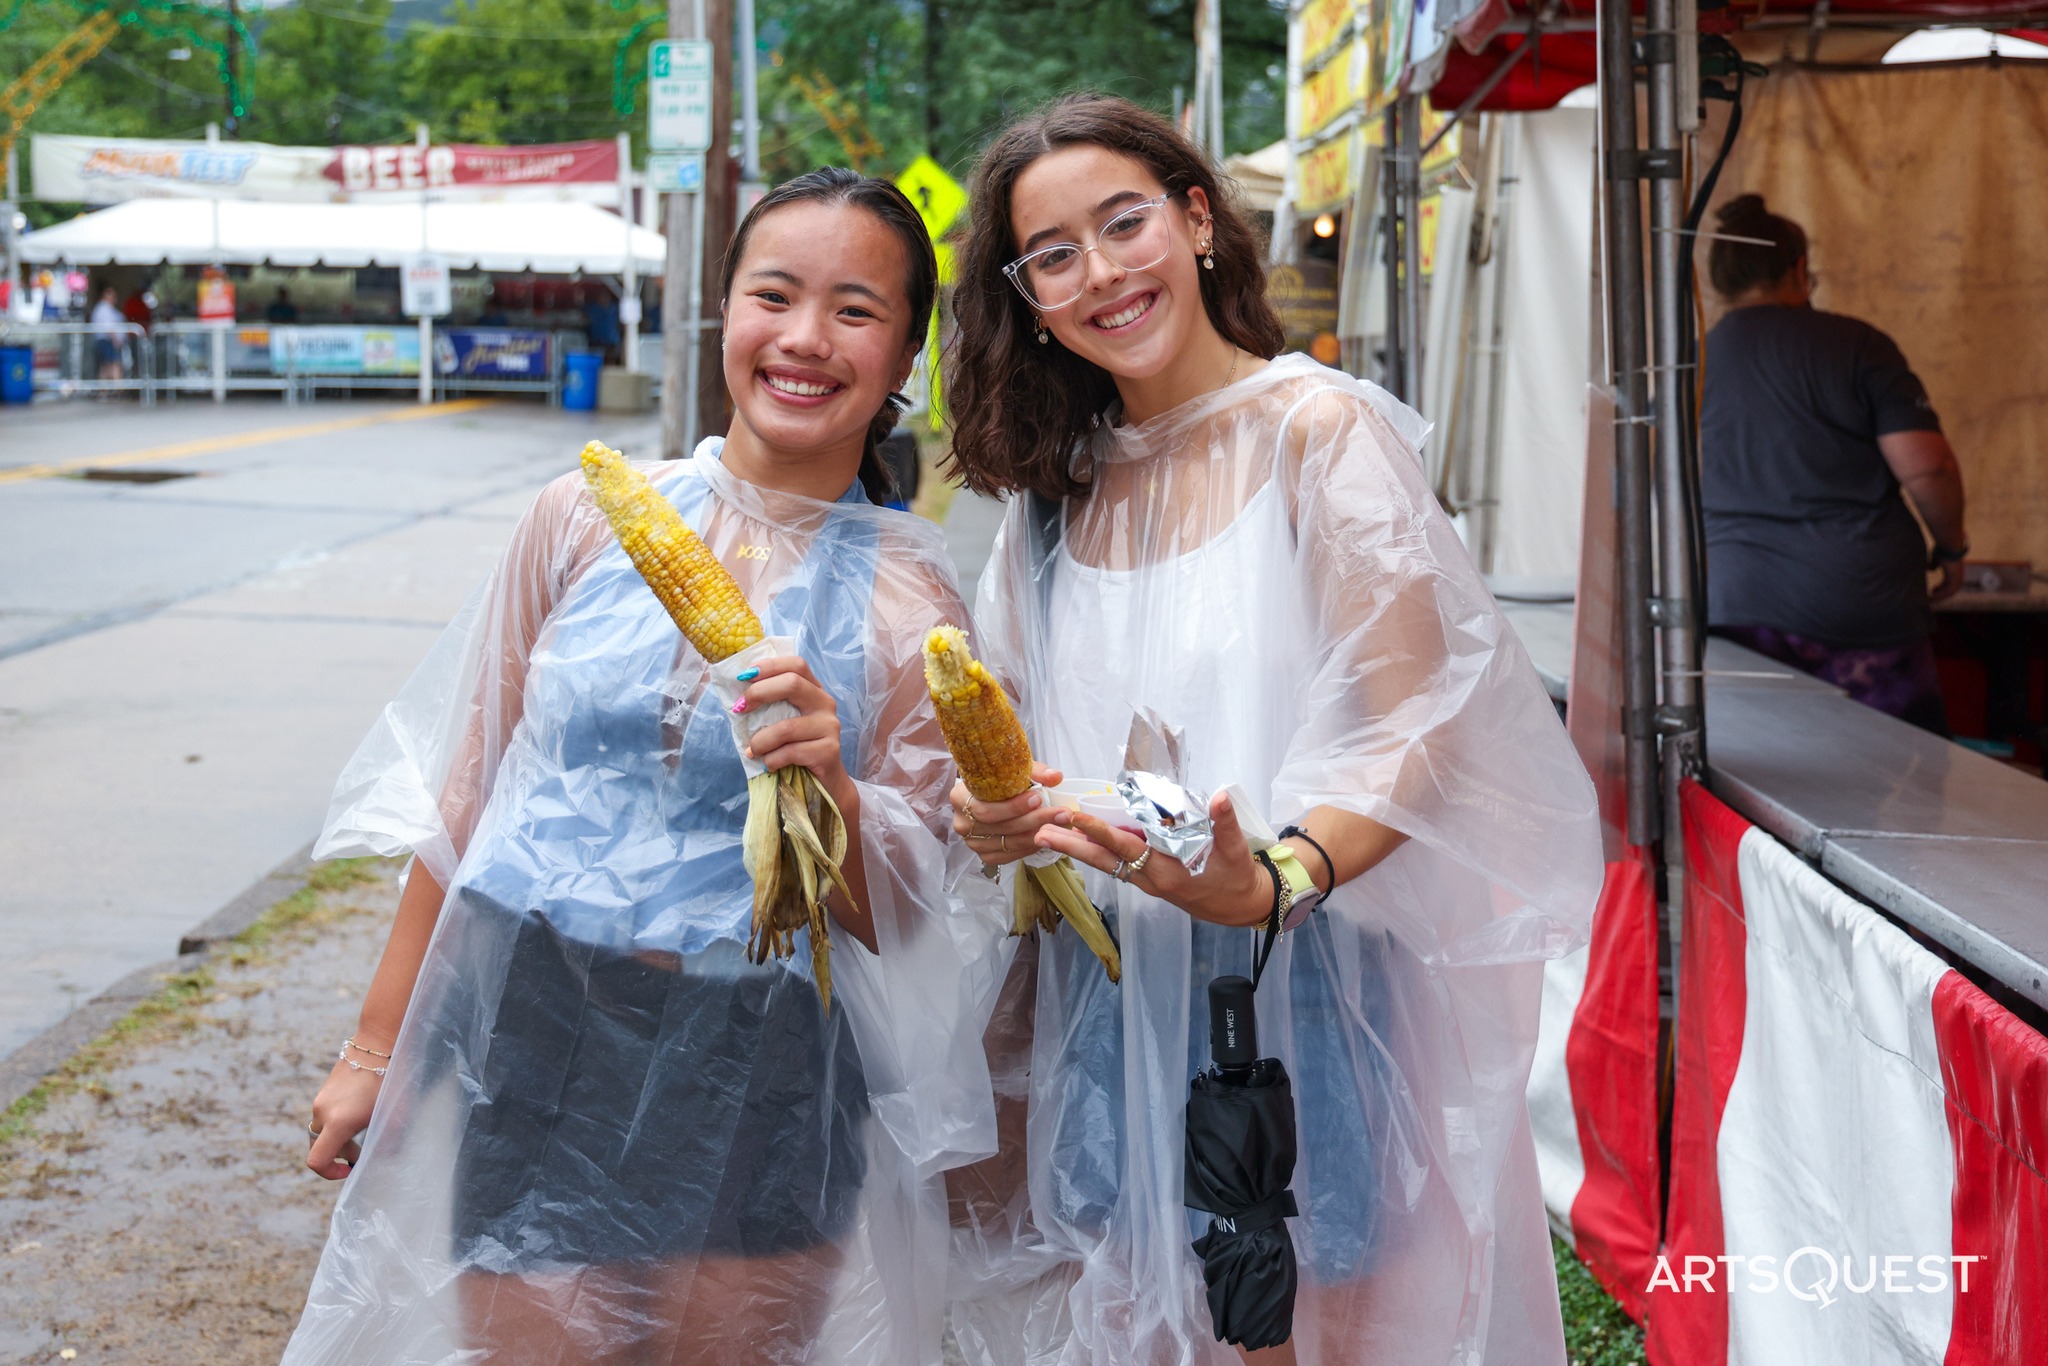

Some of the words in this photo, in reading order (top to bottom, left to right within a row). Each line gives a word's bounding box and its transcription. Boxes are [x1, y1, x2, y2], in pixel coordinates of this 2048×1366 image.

[342, 147, 456, 190] BEER
[1226, 1008, 1235, 1029] WEST
[1227, 1029, 1236, 1048] NINE
